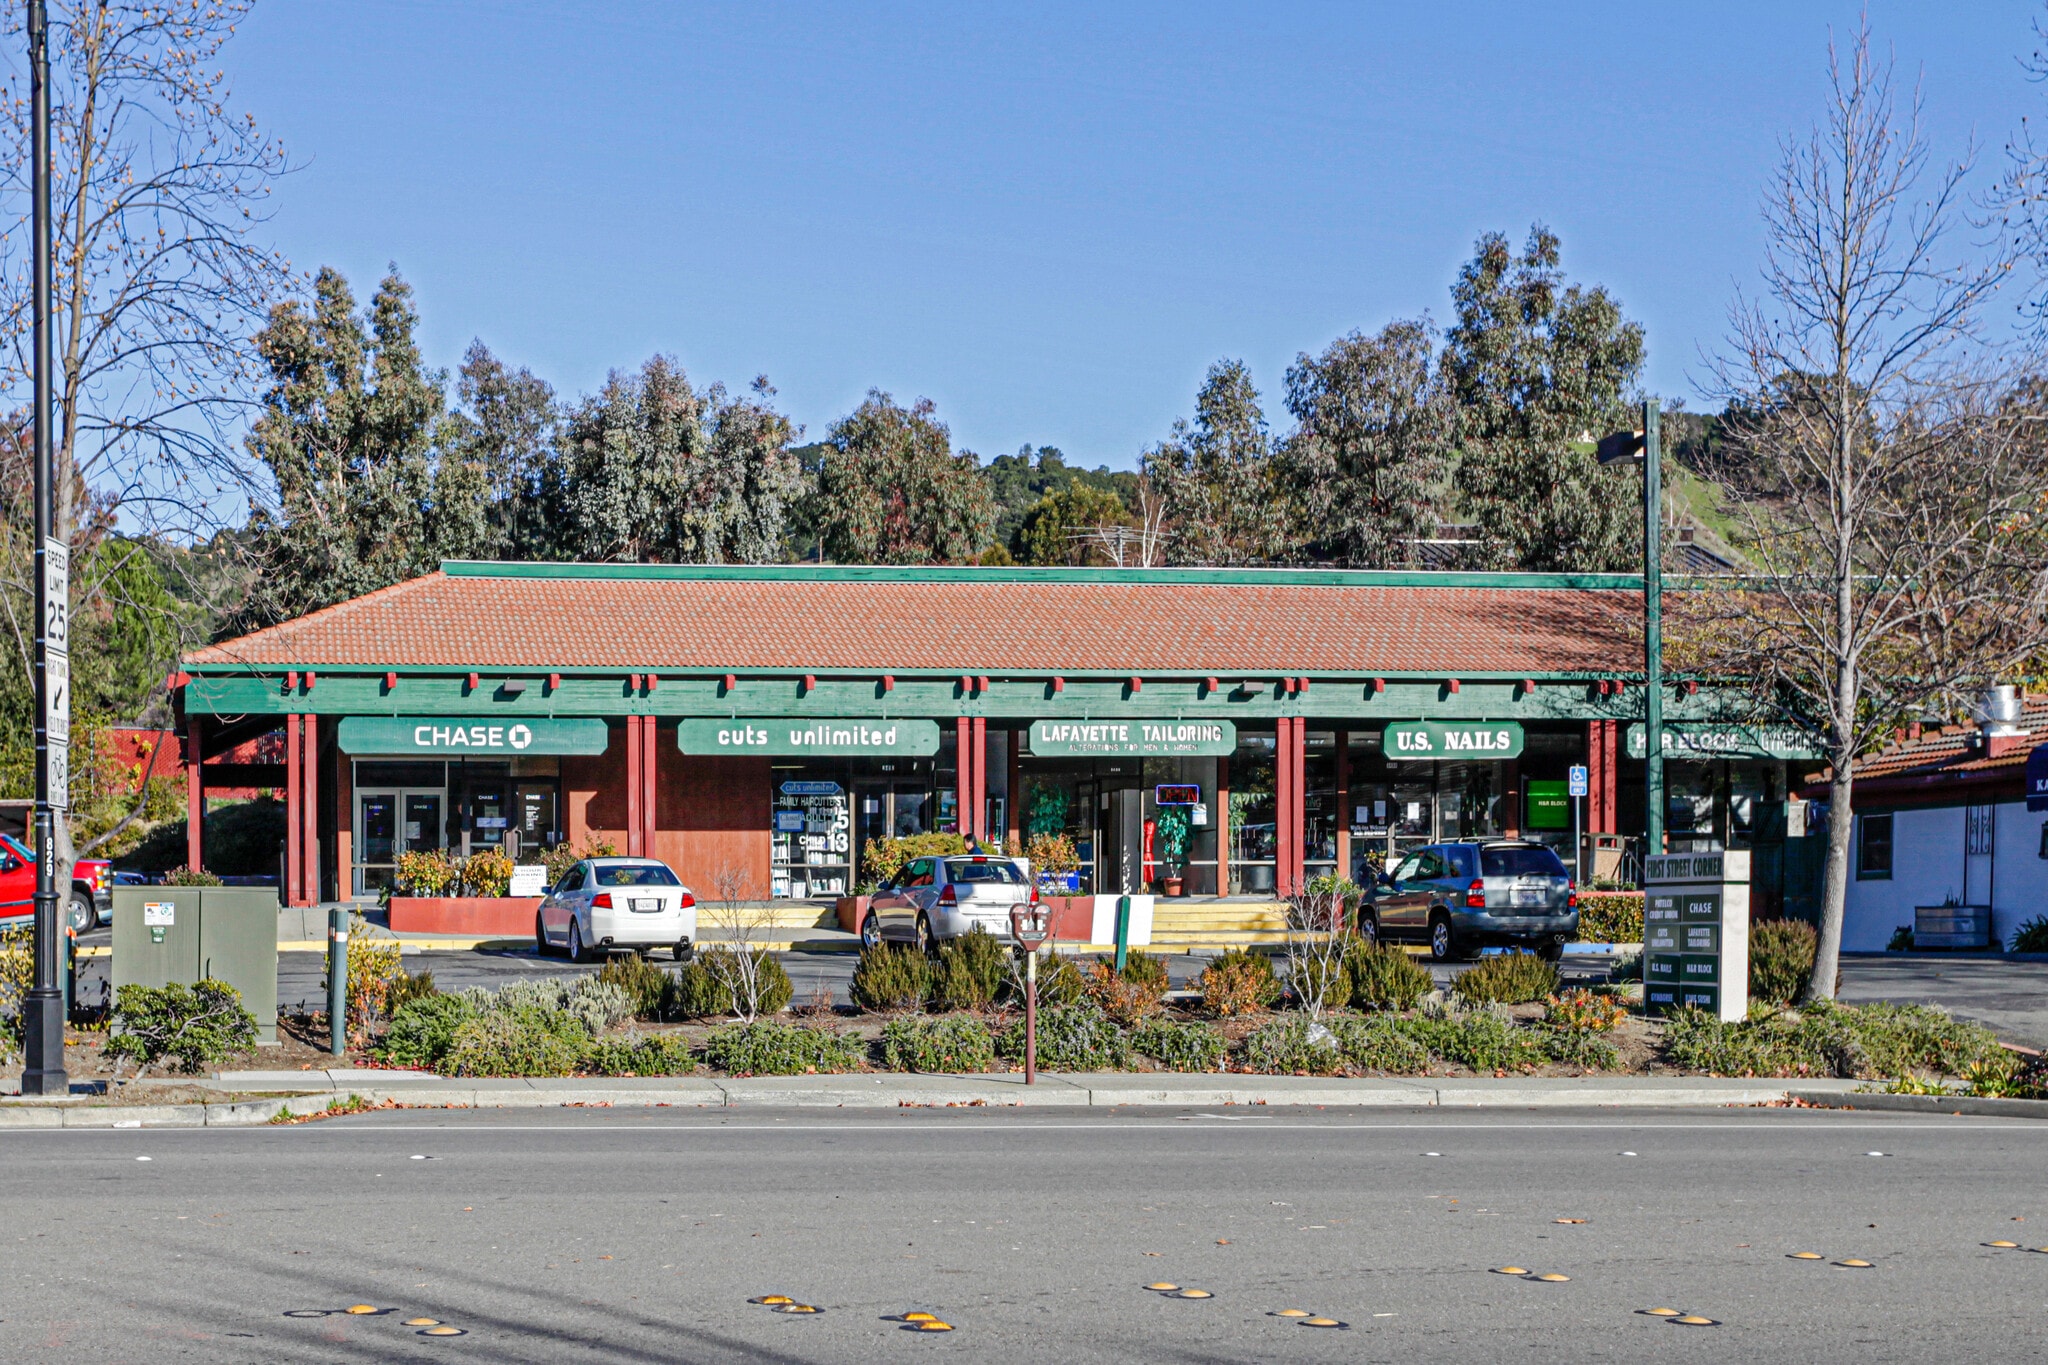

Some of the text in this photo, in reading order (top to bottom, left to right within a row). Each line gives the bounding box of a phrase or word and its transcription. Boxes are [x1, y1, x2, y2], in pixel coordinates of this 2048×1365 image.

[48, 550, 65, 571] SPEED
[50, 575, 64, 595] LIMIT
[48, 600, 65, 641] 25
[414, 726, 504, 746] CHASE
[718, 726, 896, 745] cuts unlimited
[1042, 725, 1223, 742] LAFAYETTE TAILORING
[1397, 731, 1510, 750] U.S. NAILS
[1069, 743, 1119, 752] ALTERATIONS
[780, 796, 841, 807] FAMILY HAIRCUTTERS
[1158, 787, 1197, 802] OPEN
[46, 837, 54, 876] 829
[1647, 857, 1722, 878] FIRST STREET CORNER
[1689, 902, 1712, 913] CHASE
[1698, 964, 1712, 973] BLOCK
